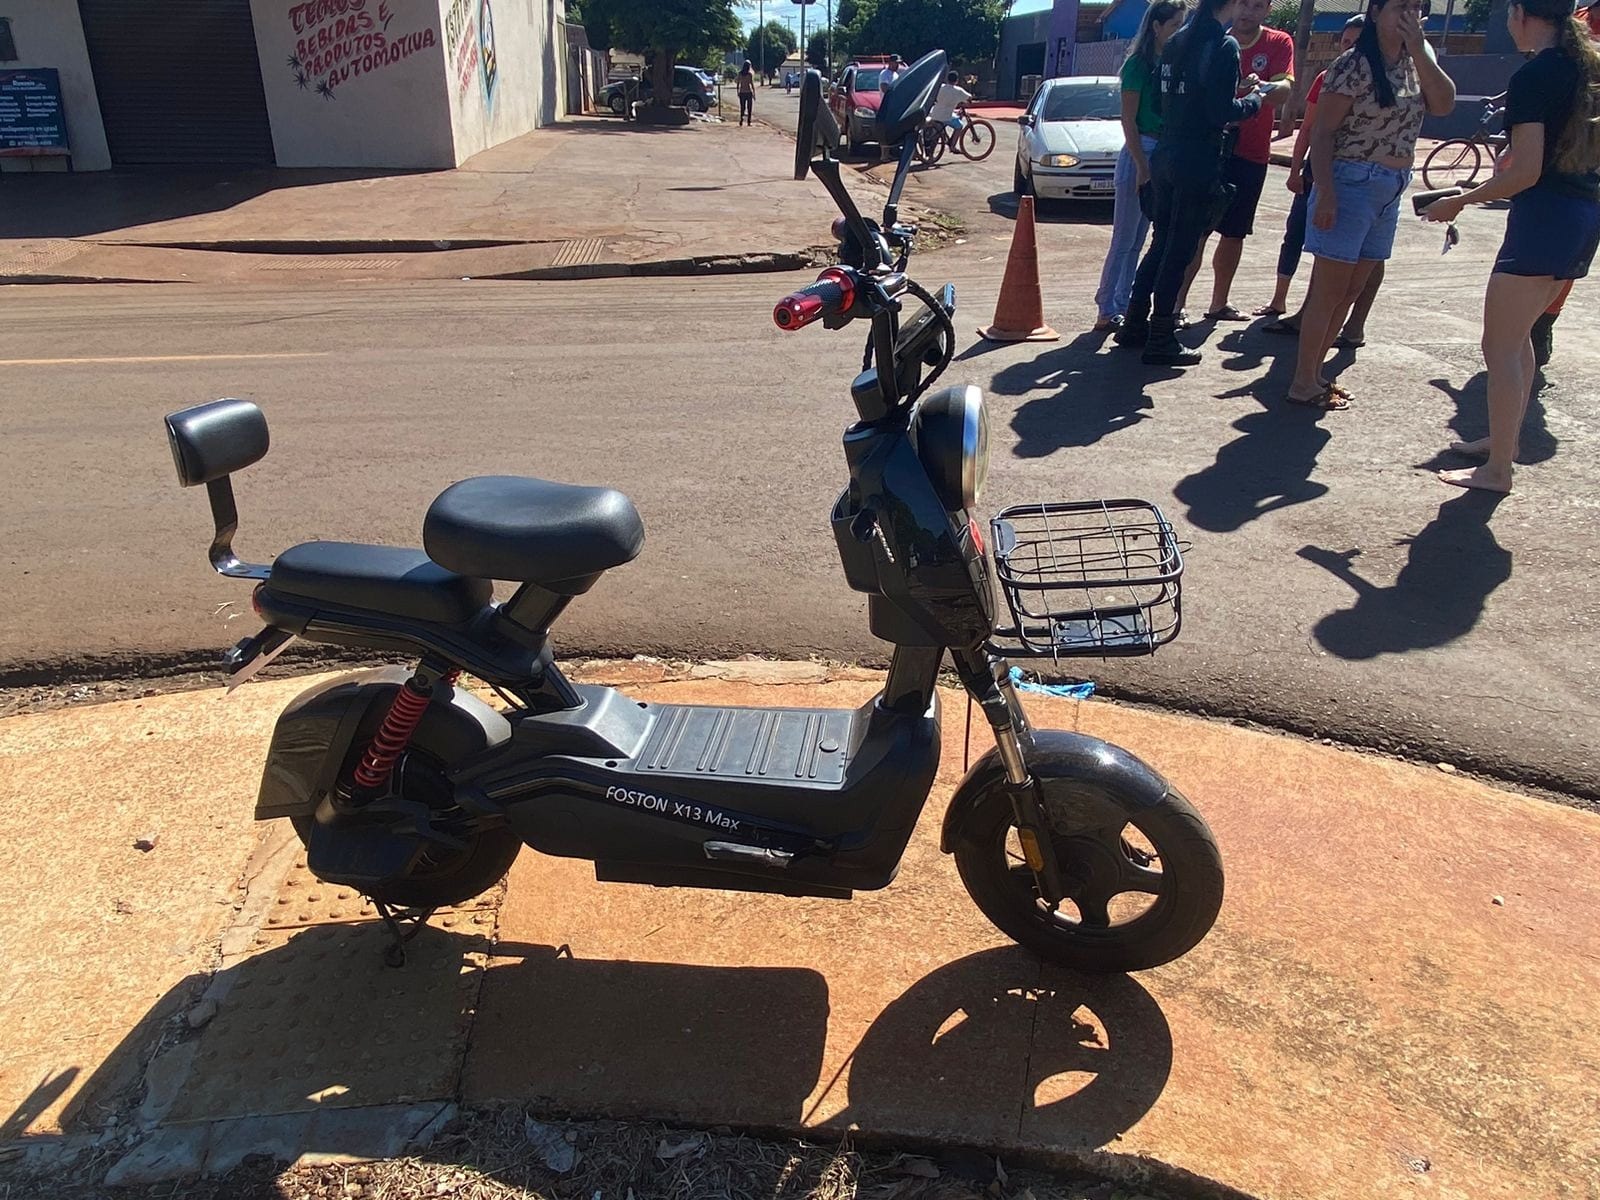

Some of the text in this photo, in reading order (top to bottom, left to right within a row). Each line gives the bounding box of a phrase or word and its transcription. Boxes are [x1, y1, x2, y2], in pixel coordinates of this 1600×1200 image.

[296, 11, 374, 60] BEBIDAS
[304, 32, 387, 78] PRODUTOS
[328, 28, 435, 89] AUTOMOTIVA
[606, 786, 740, 830] FOSTON X13 Max
